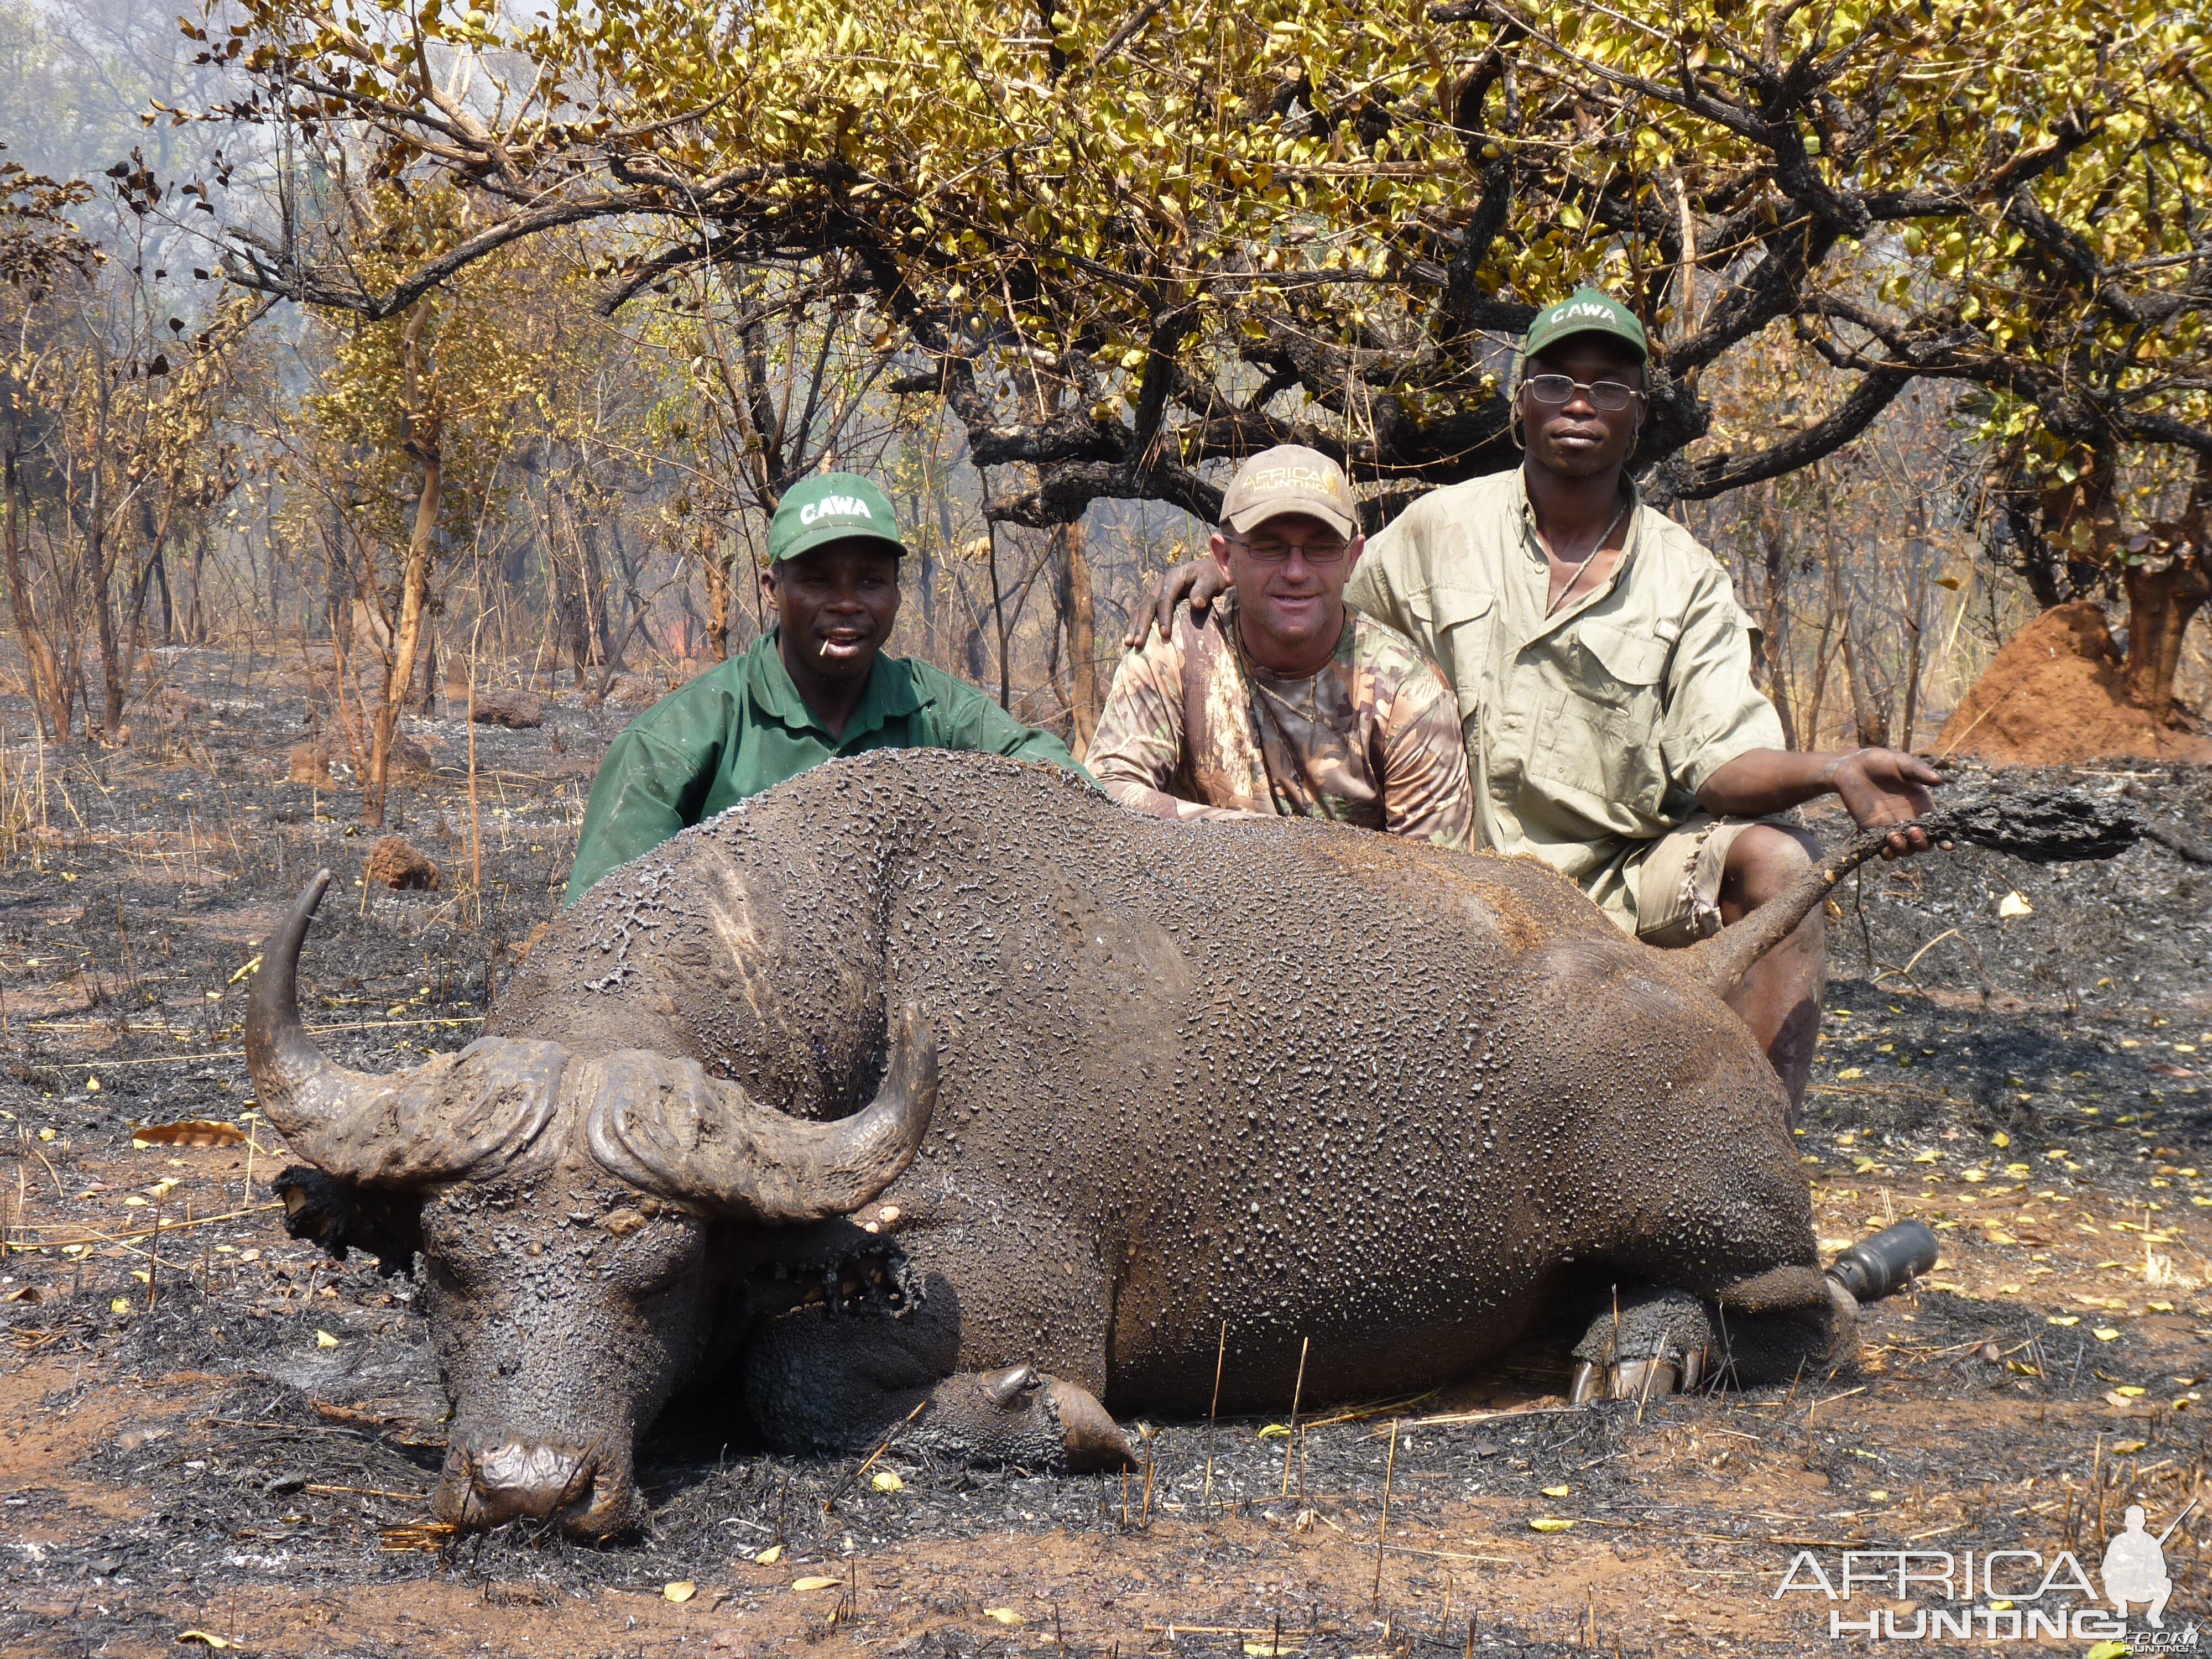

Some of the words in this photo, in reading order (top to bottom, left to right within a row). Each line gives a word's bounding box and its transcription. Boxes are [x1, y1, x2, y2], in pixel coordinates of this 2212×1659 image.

[1551, 302, 1617, 324] CAWA
[1241, 467, 1323, 489] AFRICA
[1253, 478, 1328, 494] HUNTING
[800, 495, 872, 525] CAWA
